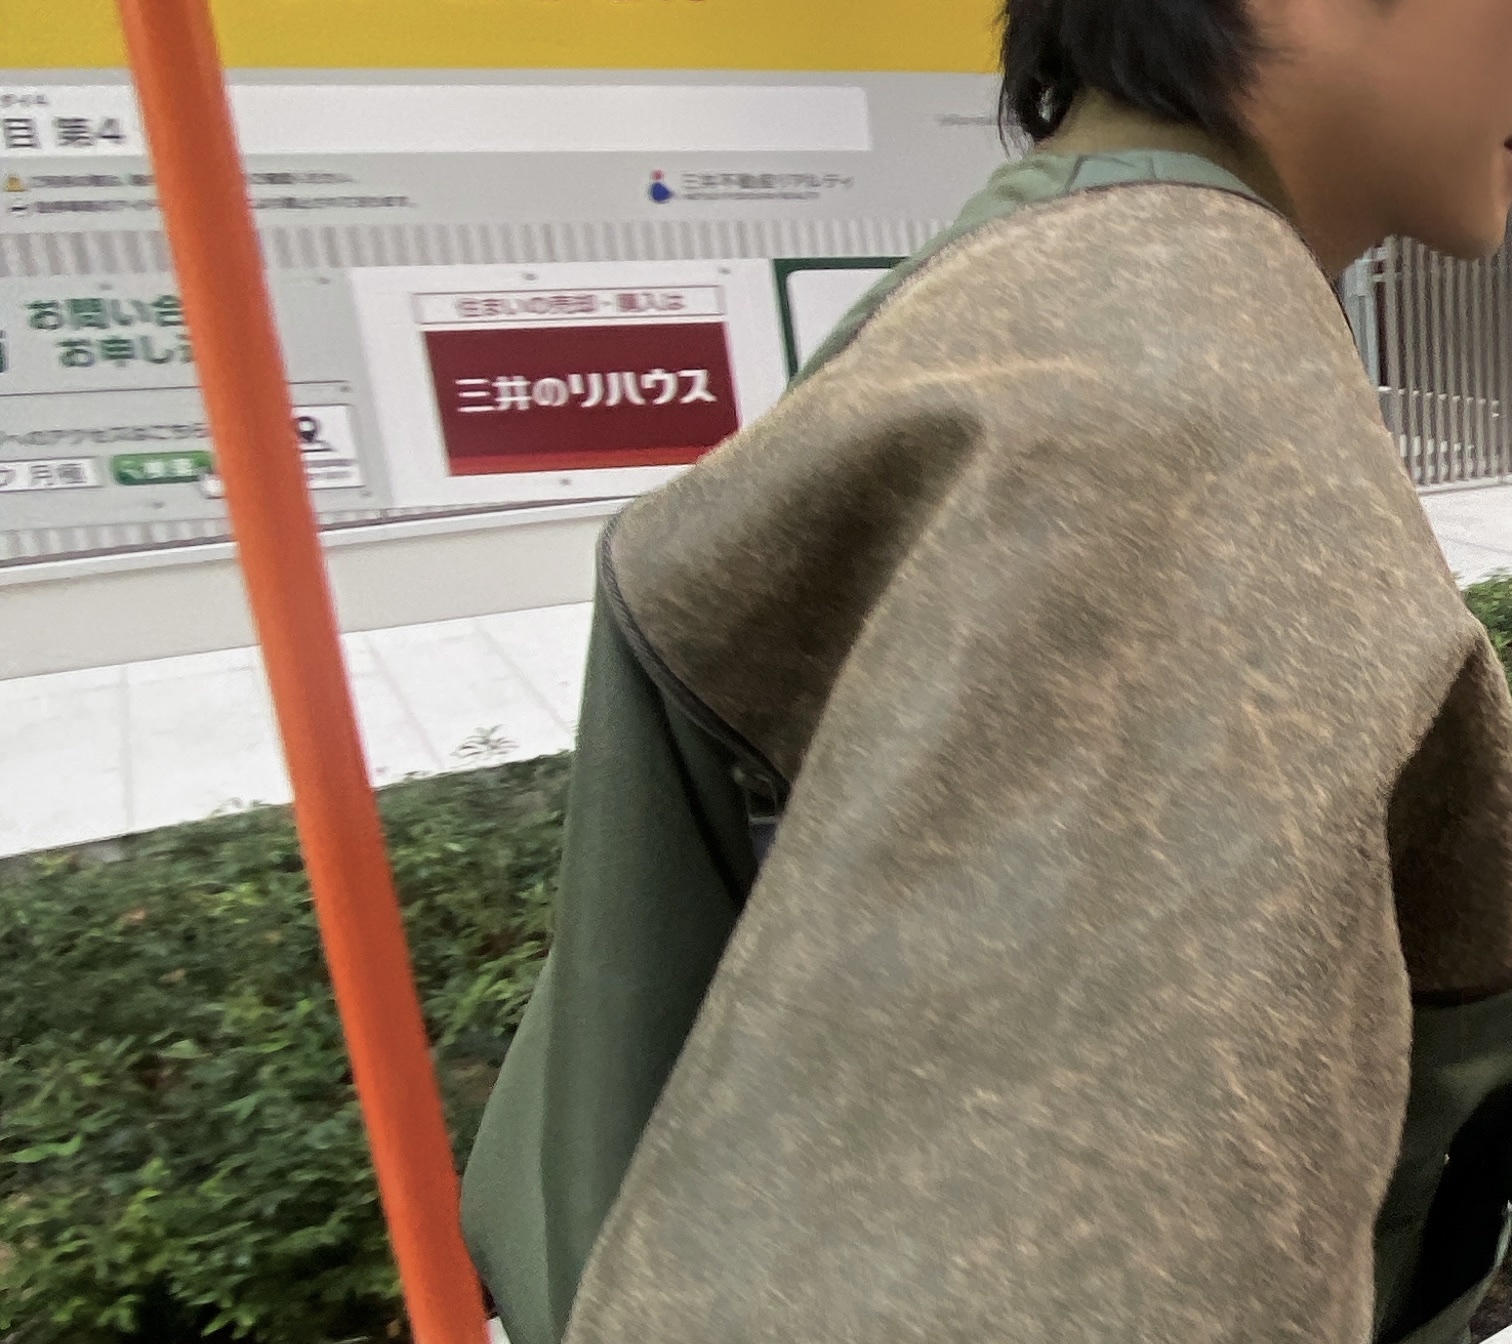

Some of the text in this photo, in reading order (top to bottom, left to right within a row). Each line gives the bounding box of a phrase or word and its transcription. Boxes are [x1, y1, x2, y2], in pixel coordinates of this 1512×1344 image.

[25, 294, 188, 331] お問い合
[454, 368, 719, 413] 三井のリハウス
